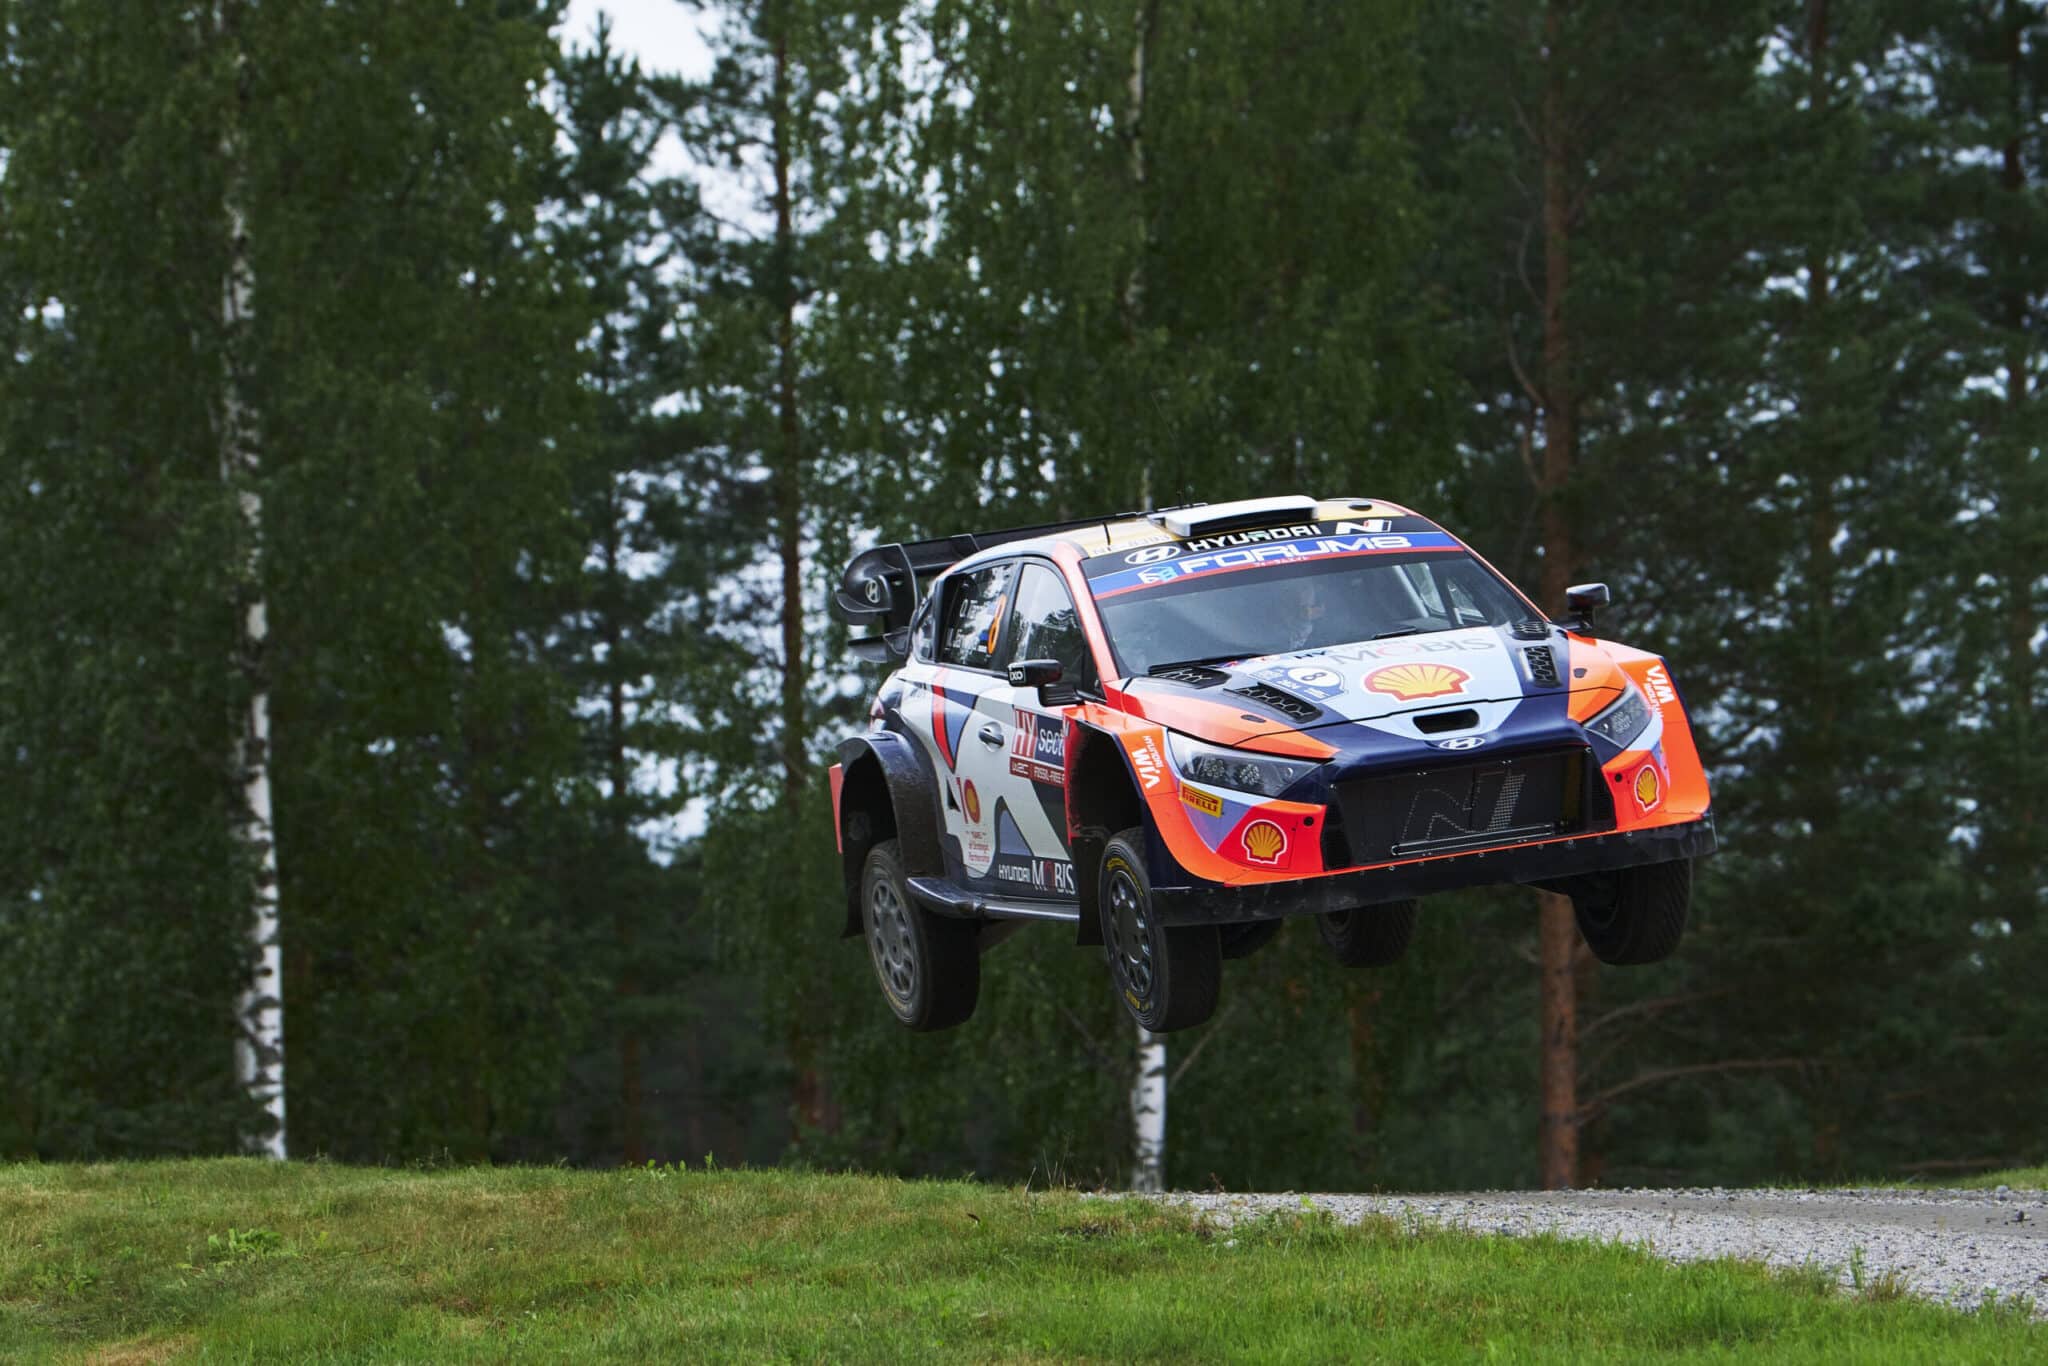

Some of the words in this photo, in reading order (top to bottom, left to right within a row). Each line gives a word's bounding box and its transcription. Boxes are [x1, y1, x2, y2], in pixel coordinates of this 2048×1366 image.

[1186, 523, 1323, 552] HYUNDAI
[1178, 536, 1412, 574] FORUM8
[1328, 638, 1497, 665] MOBIS
[1301, 671, 1328, 681] 8
[1182, 786, 1219, 813] PIRELLI
[998, 863, 1031, 883] HYUNDAI
[1032, 859, 1076, 895] MOBIS
